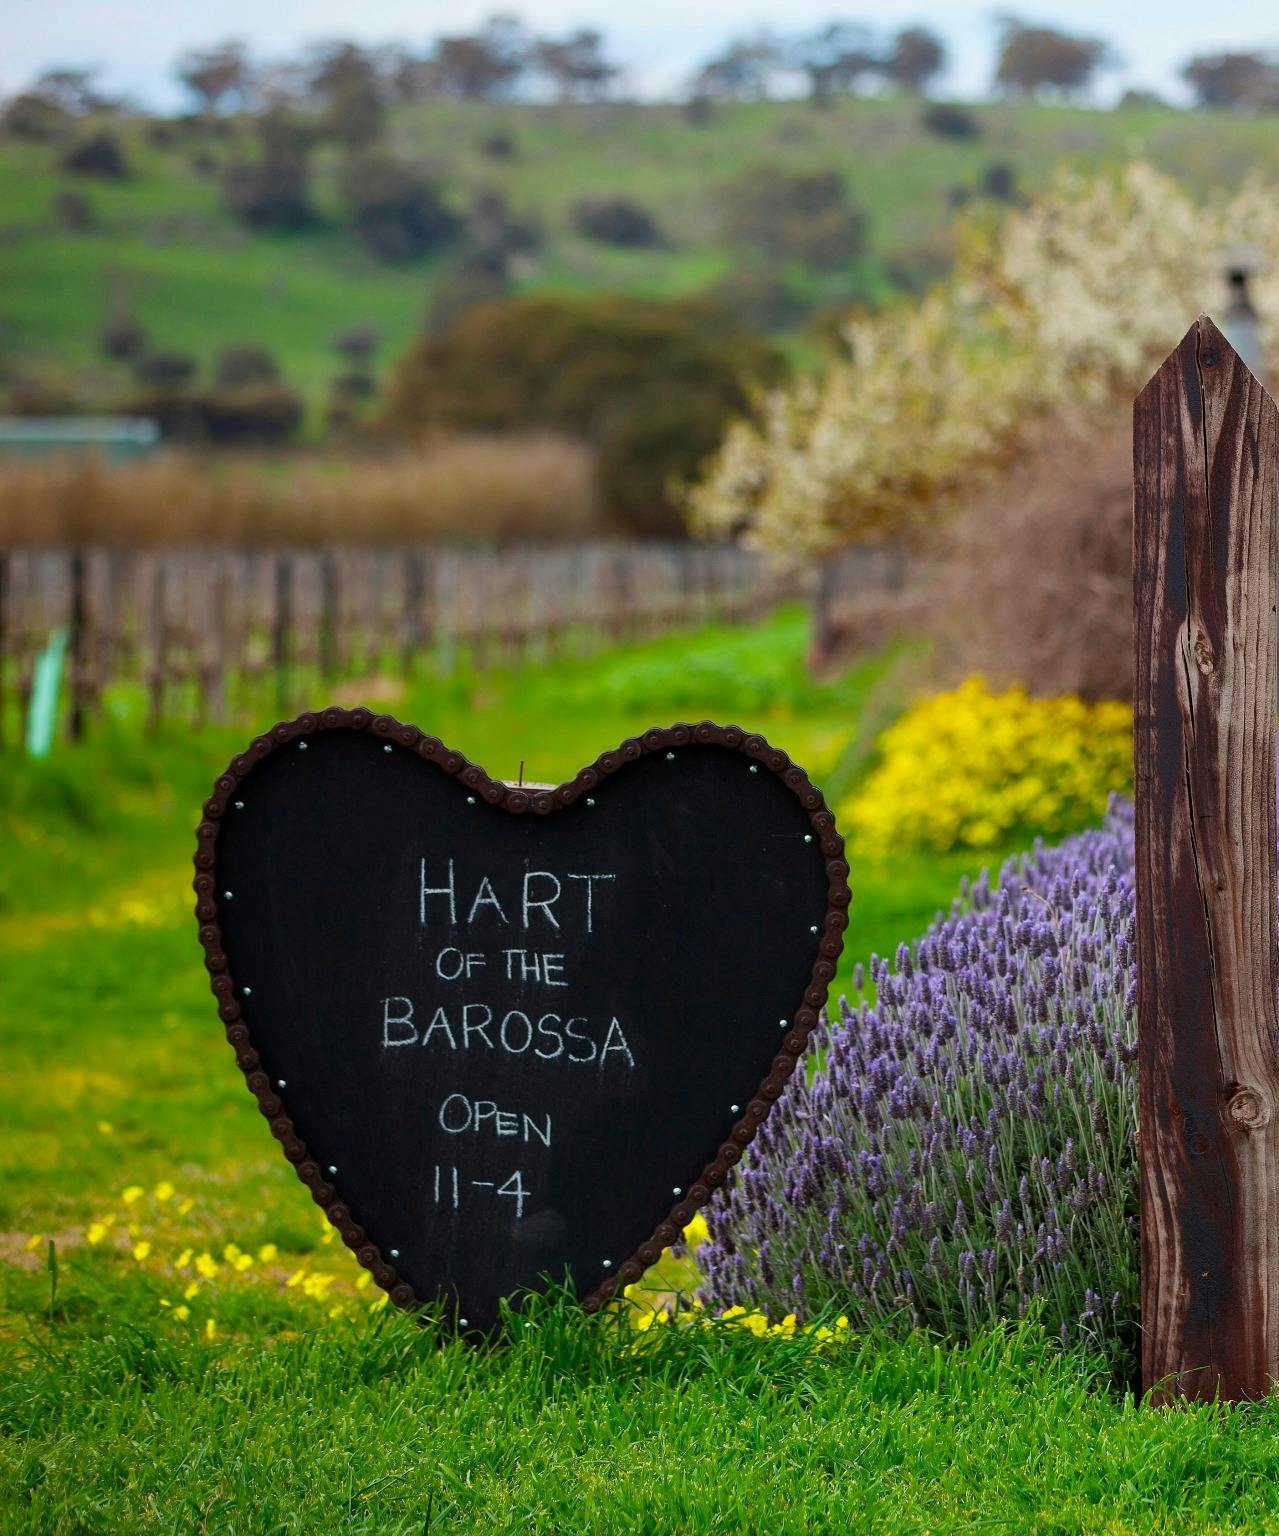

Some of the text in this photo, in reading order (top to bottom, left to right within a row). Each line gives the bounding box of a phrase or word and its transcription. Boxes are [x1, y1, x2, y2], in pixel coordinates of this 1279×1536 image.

[420, 858, 616, 932] HART
[435, 946, 569, 986] OF THE
[380, 996, 636, 1068] BAROSSA
[438, 1093, 552, 1148] OPEN
[433, 1165, 532, 1218] 11-4
